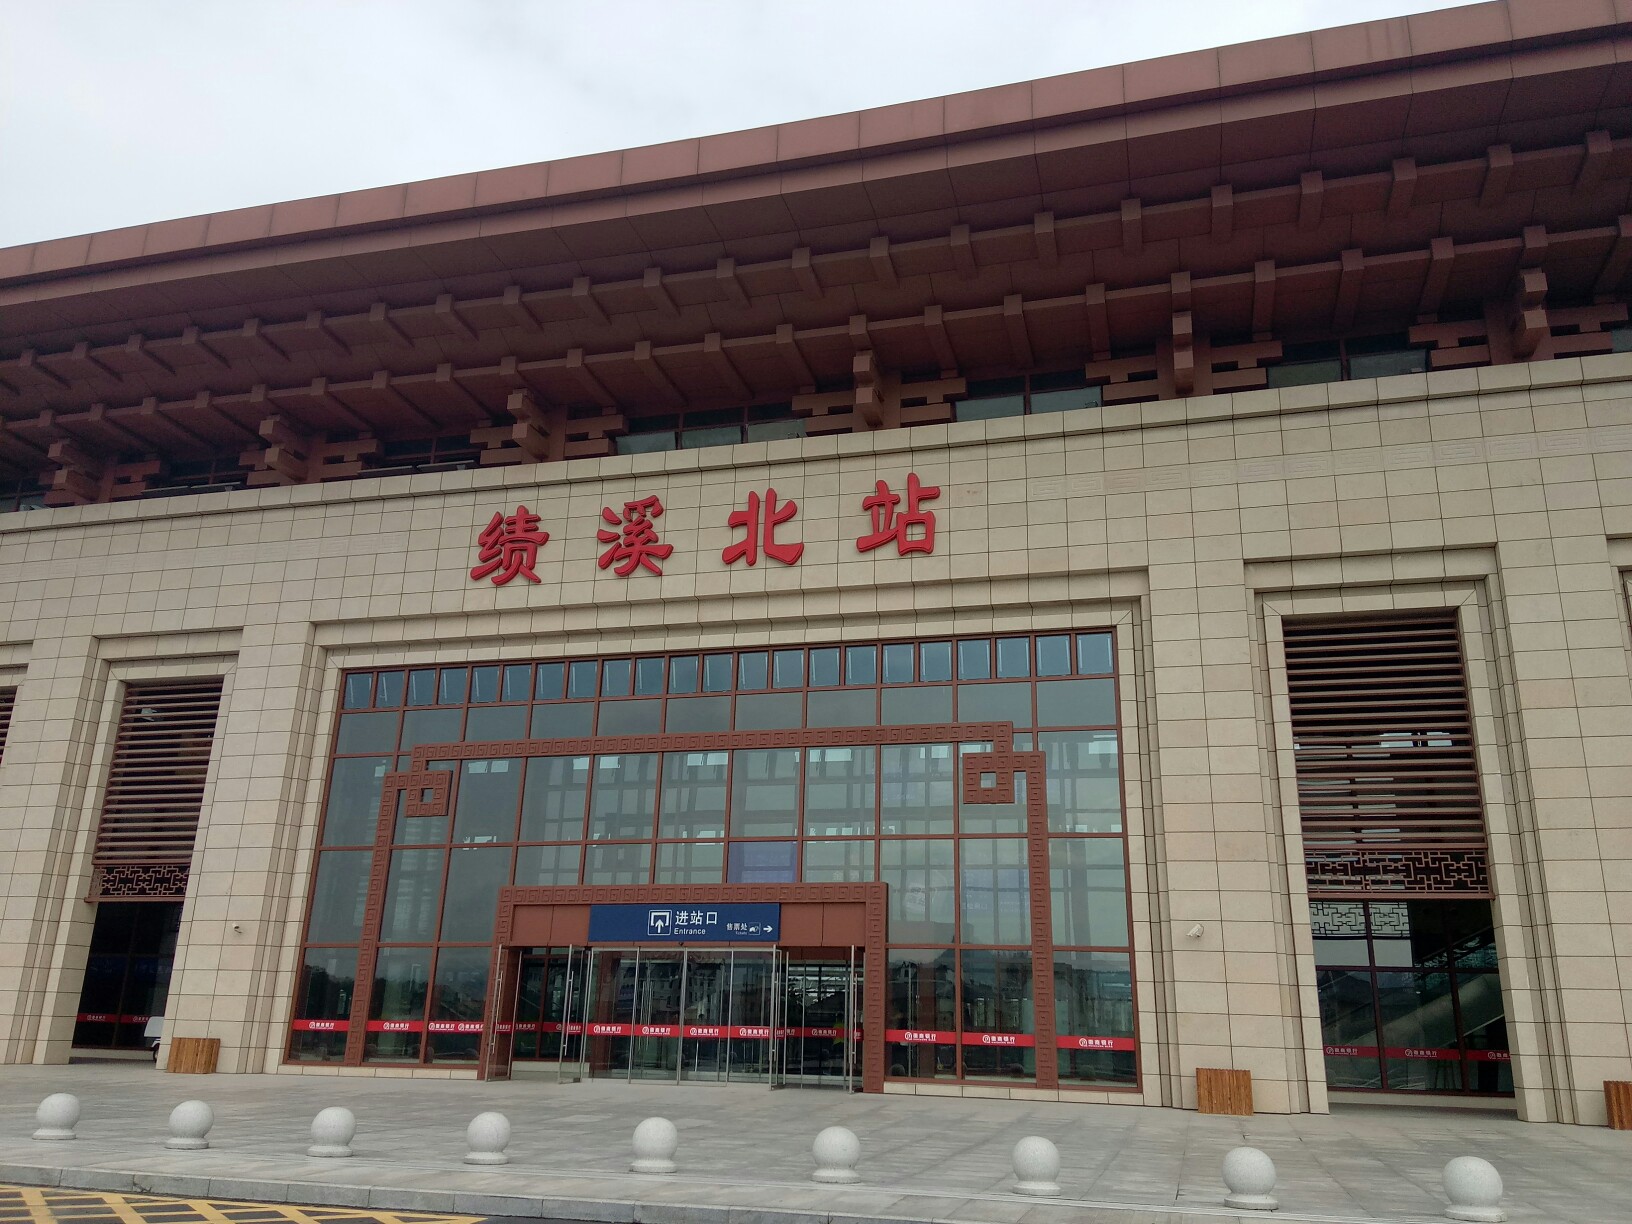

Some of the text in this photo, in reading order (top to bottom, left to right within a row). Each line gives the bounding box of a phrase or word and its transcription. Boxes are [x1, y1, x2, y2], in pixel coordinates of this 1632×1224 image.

[470, 472, 940, 586] 绩溪北站
[675, 910, 718, 925] 进站口
[674, 927, 706, 935] Entrance
[726, 922, 748, 931] 售票处
